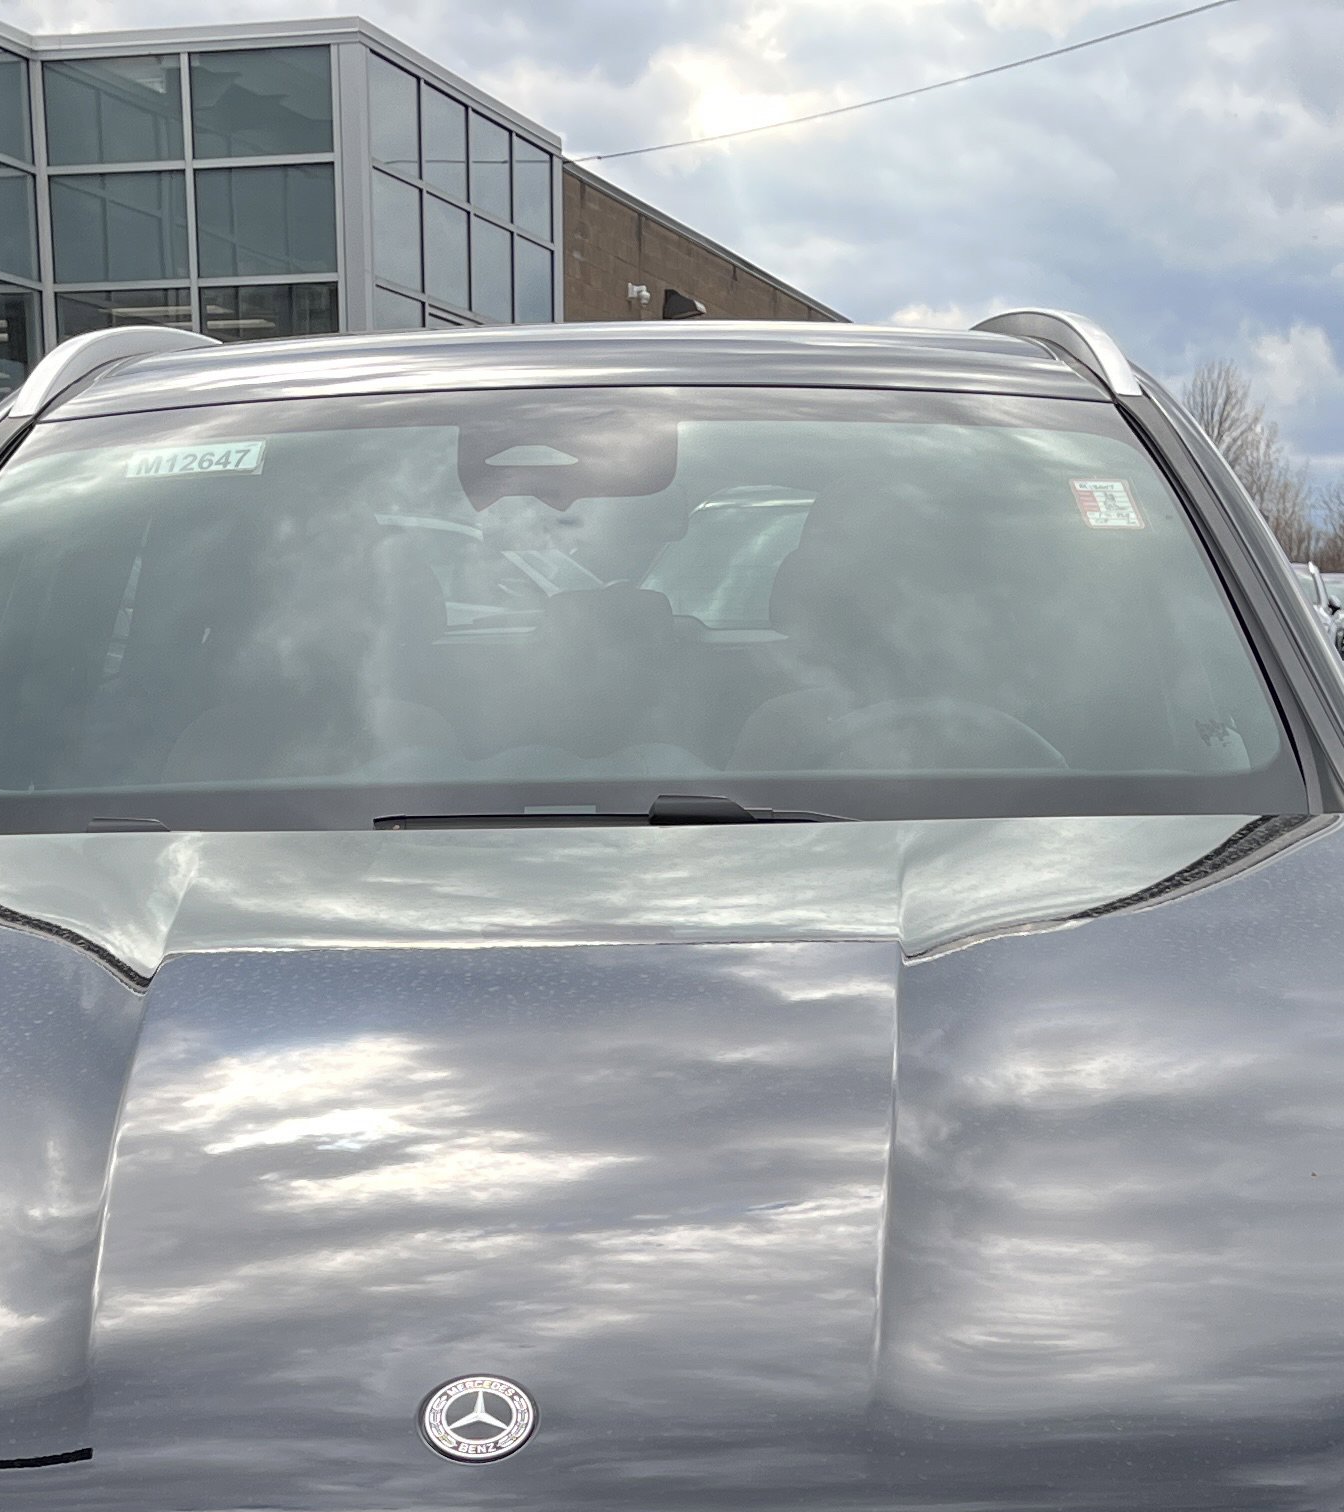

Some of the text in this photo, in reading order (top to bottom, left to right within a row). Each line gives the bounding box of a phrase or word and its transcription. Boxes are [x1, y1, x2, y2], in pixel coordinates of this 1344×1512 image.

[135, 448, 252, 475] M12647
[447, 1379, 514, 1397] MERCEDES
[458, 1442, 497, 1454] BENZ
